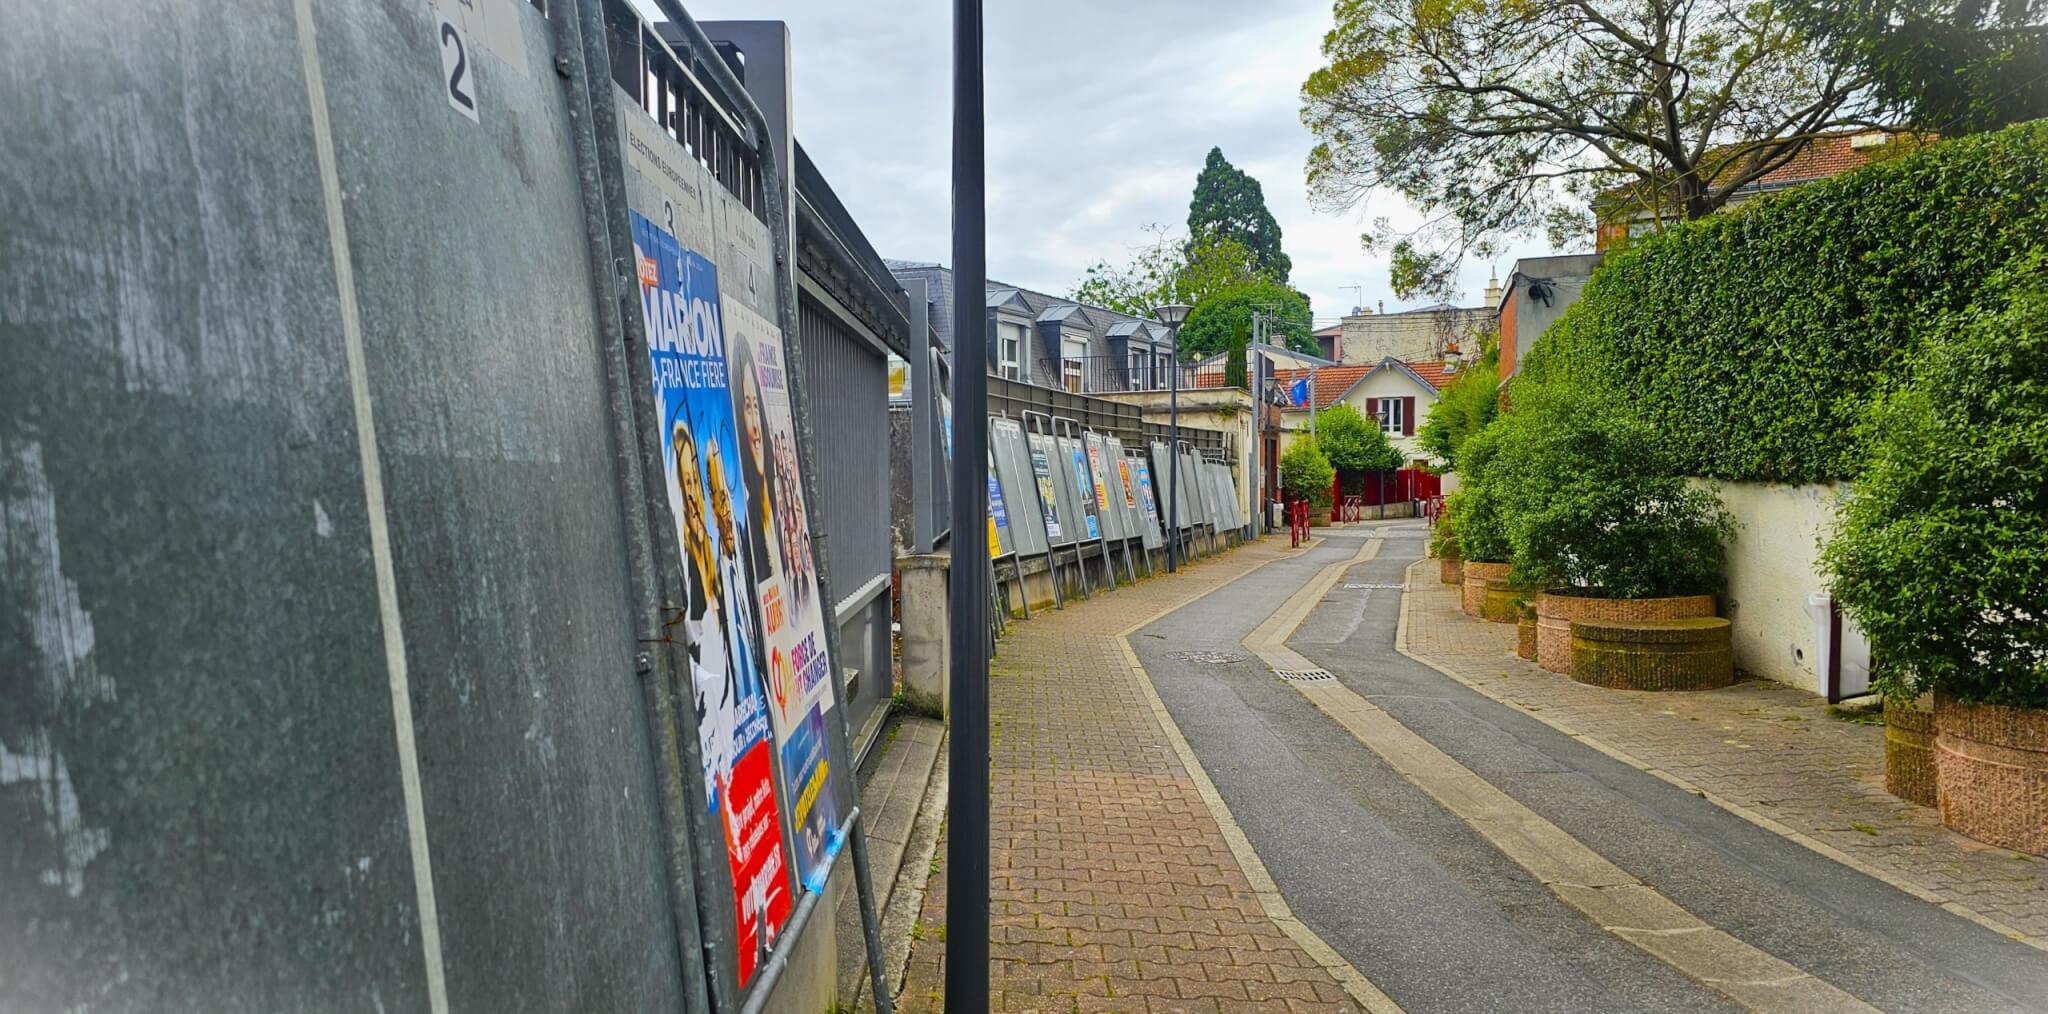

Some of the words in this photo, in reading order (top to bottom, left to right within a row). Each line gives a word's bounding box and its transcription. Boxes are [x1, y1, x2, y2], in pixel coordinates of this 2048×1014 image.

[441, 22, 474, 111] 2
[664, 201, 676, 240] 3
[639, 259, 658, 282] OTEZ
[749, 262, 757, 303] 4
[641, 287, 722, 357] MARION
[660, 358, 701, 388] FRANCE
[791, 638, 810, 676] FORCE
[808, 631, 817, 660] DE
[802, 650, 828, 695] CHANGER
